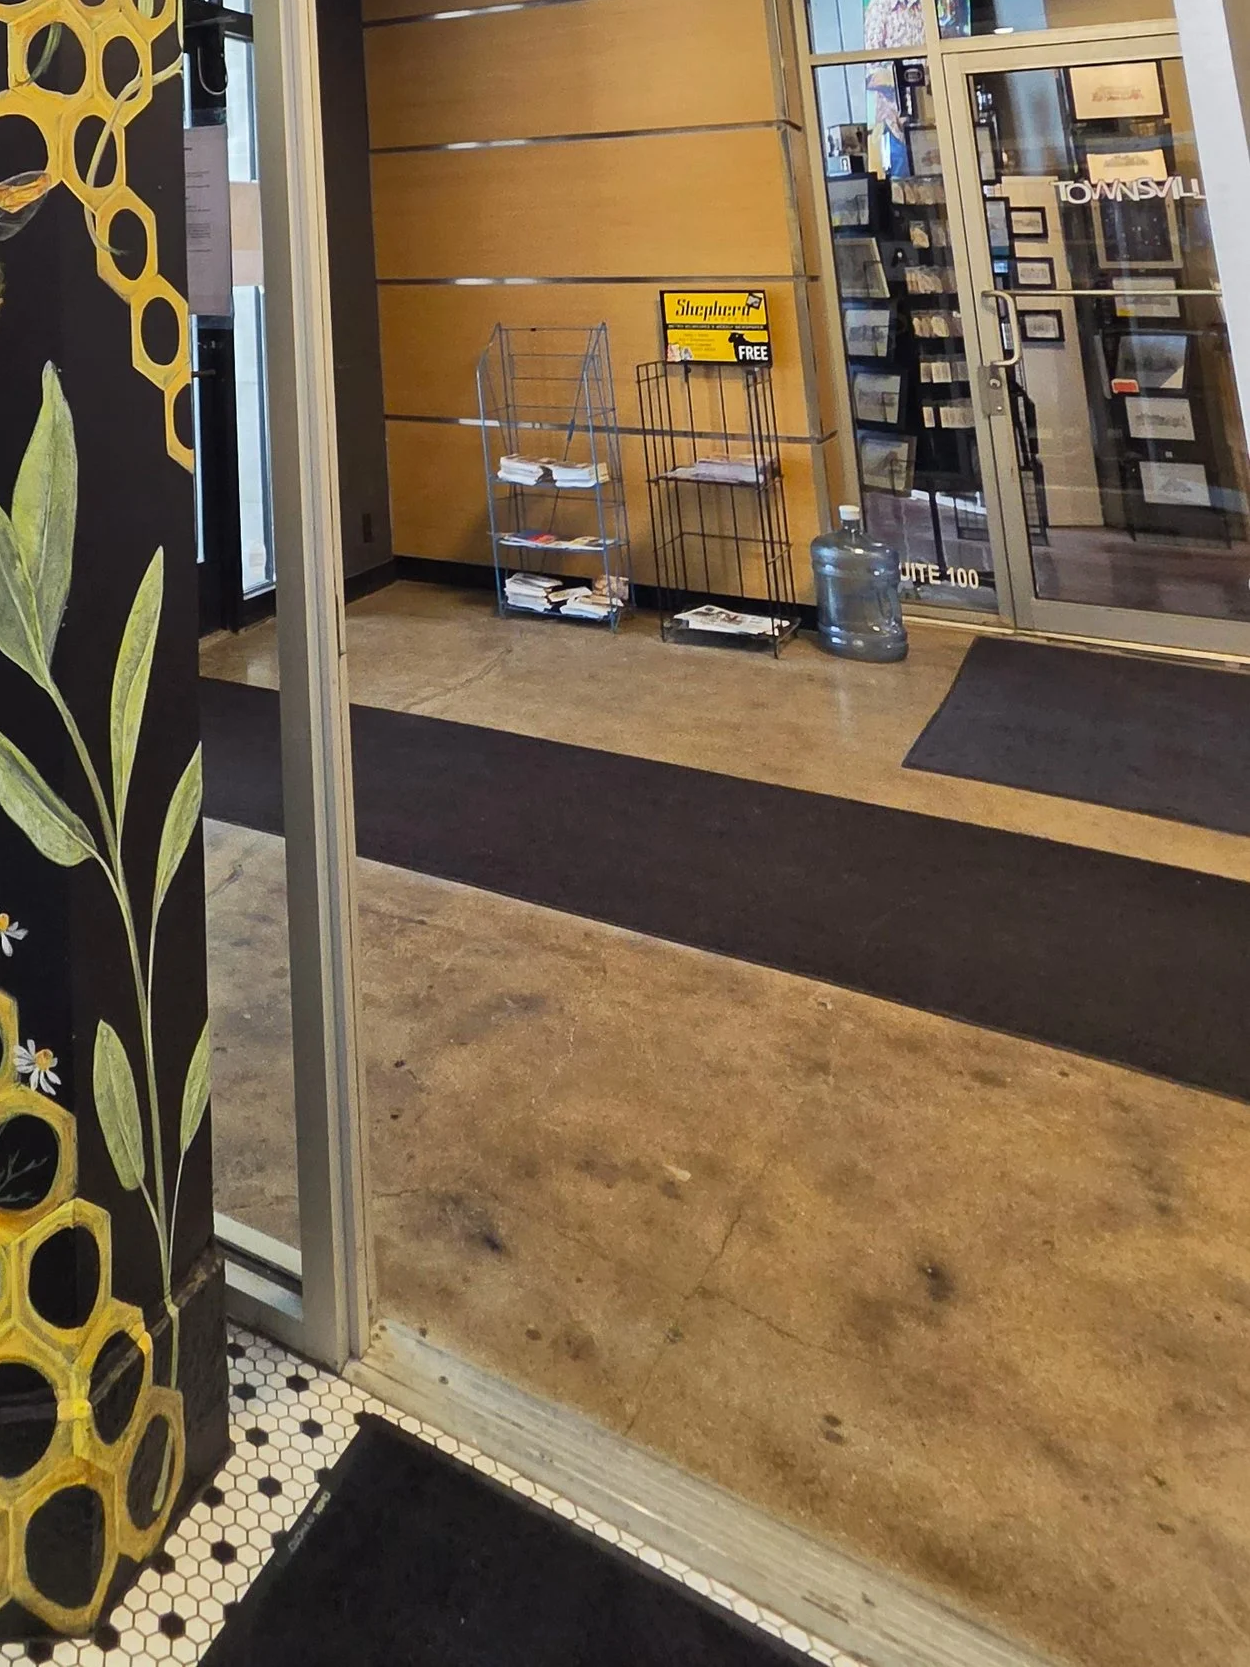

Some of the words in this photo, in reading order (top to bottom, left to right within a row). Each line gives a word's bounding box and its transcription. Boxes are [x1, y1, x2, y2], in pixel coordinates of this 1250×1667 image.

[1053, 175, 1207, 205] TOWNSVILL
[737, 345, 769, 361] FREE
[899, 561, 942, 585] UITE
[946, 566, 980, 590] 100
